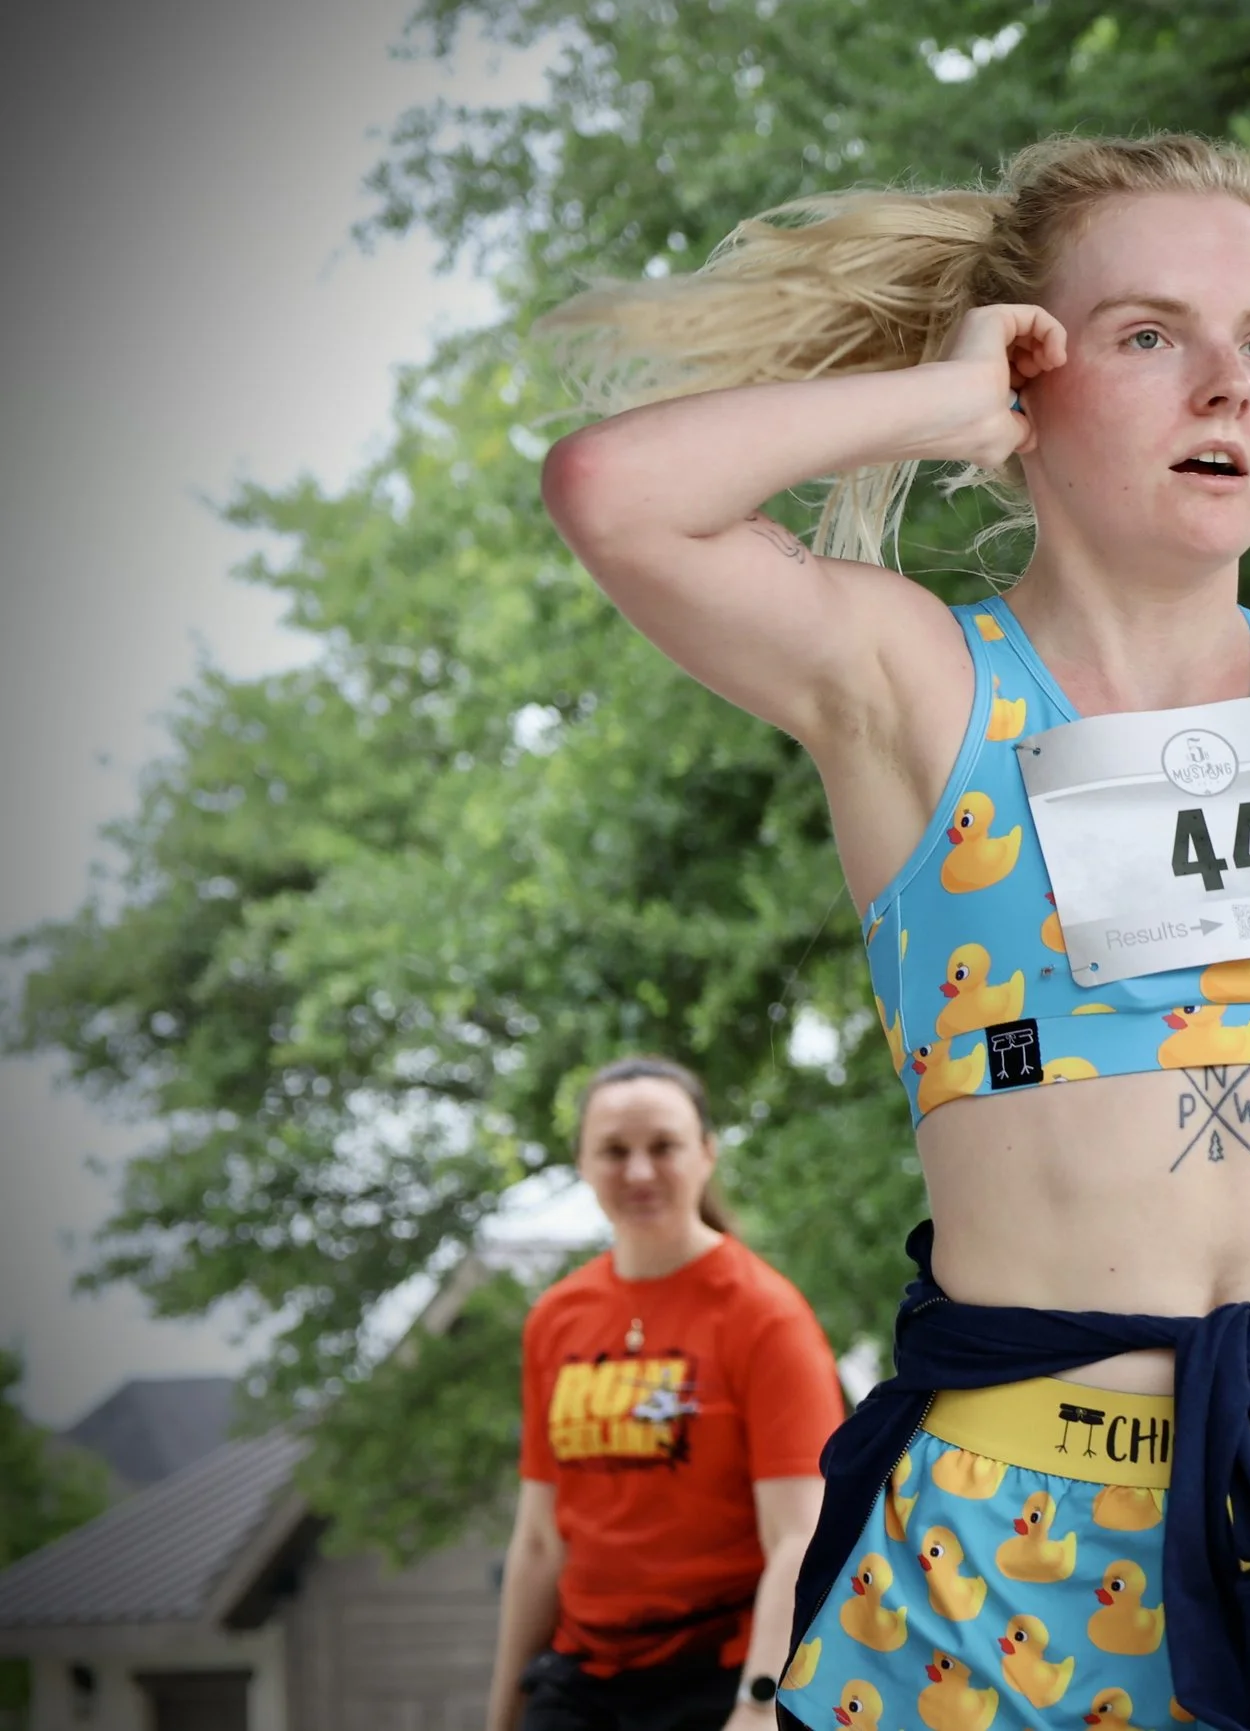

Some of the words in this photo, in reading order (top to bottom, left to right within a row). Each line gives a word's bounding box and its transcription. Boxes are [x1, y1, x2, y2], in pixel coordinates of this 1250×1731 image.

[1172, 762, 1233, 784] MUSTANG
[1105, 921, 1189, 951] Results
[1179, 1093, 1196, 1129] P
[1106, 1415, 1174, 1464] CHI
